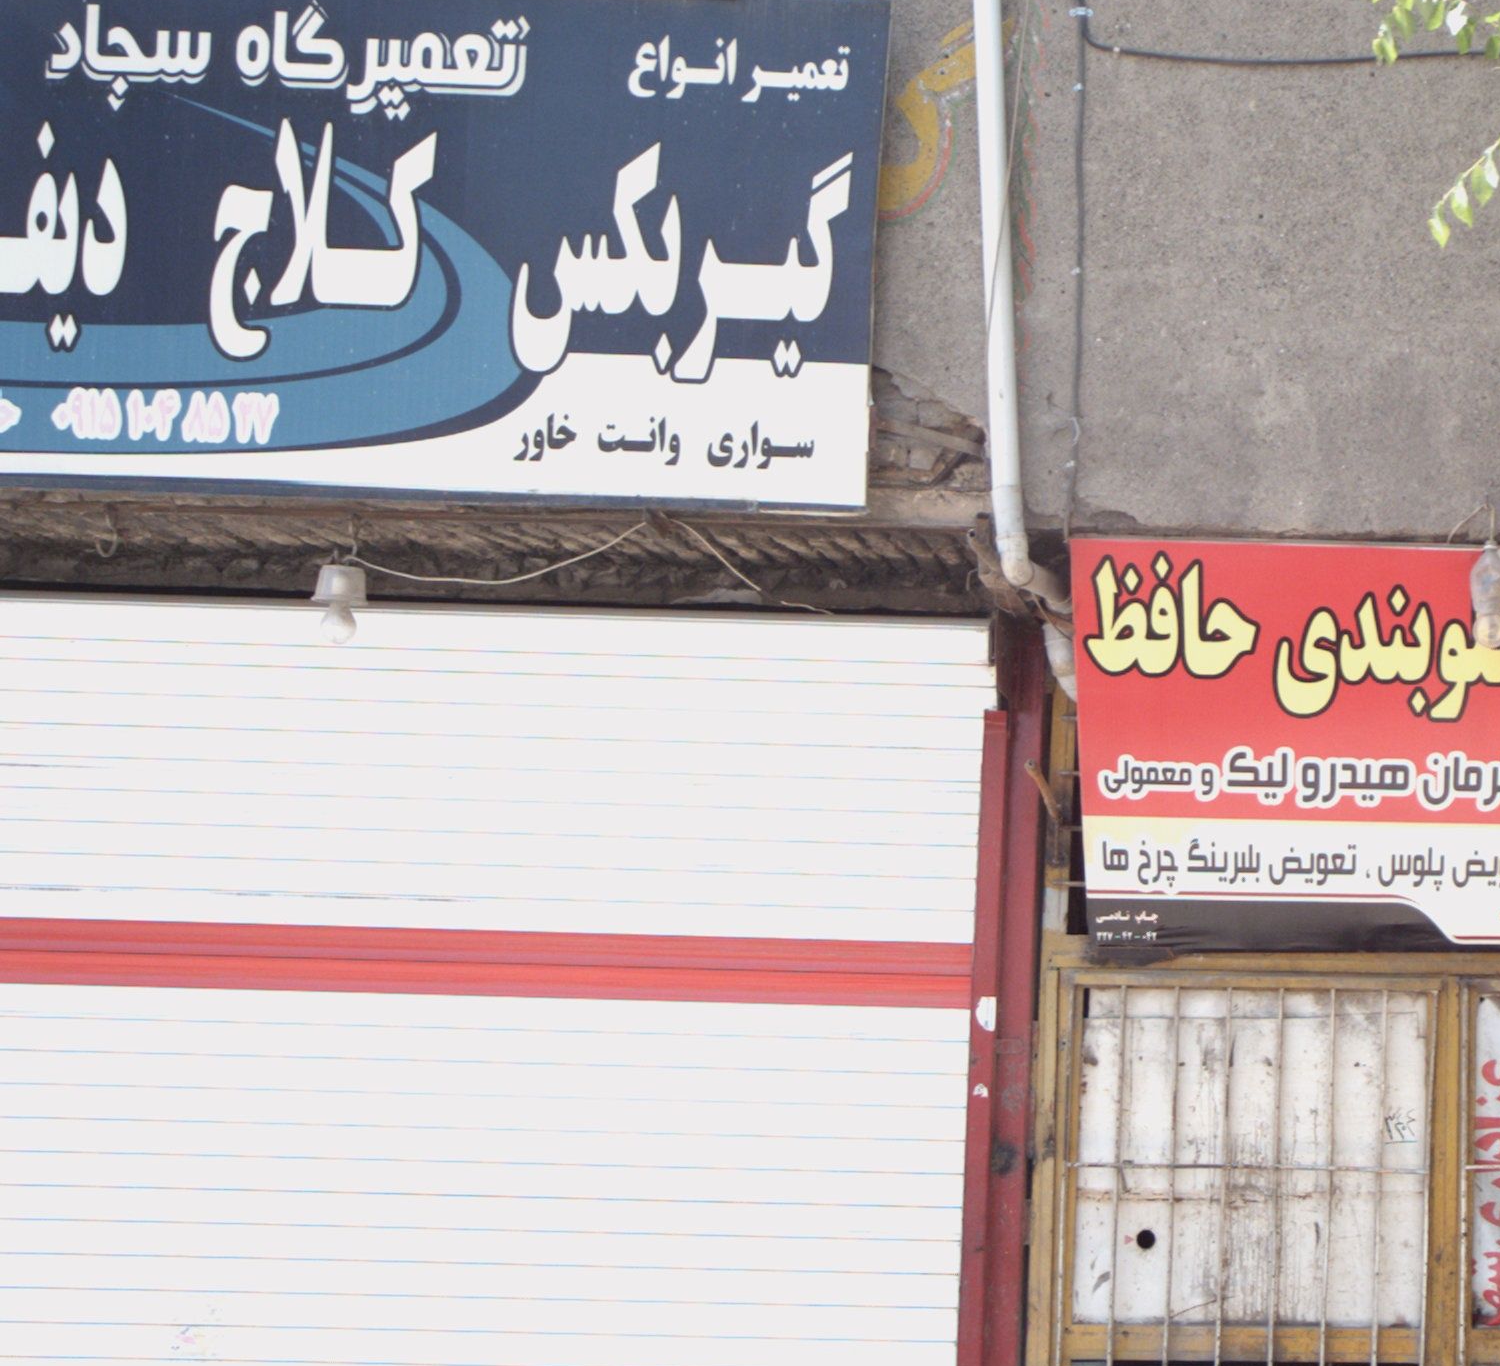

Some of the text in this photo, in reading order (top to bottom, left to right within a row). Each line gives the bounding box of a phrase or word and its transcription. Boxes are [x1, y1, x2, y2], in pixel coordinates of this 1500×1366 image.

[44, 1, 212, 112] سجاد
[627, 36, 850, 104] تعمیر انواع
[210, 117, 439, 360] کلاج
[510, 141, 854, 382] گیربکس
[513, 413, 816, 470] سواری وانت خاور
[1083, 550, 1261, 679] حافظ
[1103, 759, 1194, 796] معمولی
[1200, 771, 1214, 795] و
[1101, 840, 1129, 874] ها
[1137, 844, 1178, 890] چرخ
[1186, 838, 1261, 884] بلبرینگ
[1268, 842, 1358, 886] تعویض
